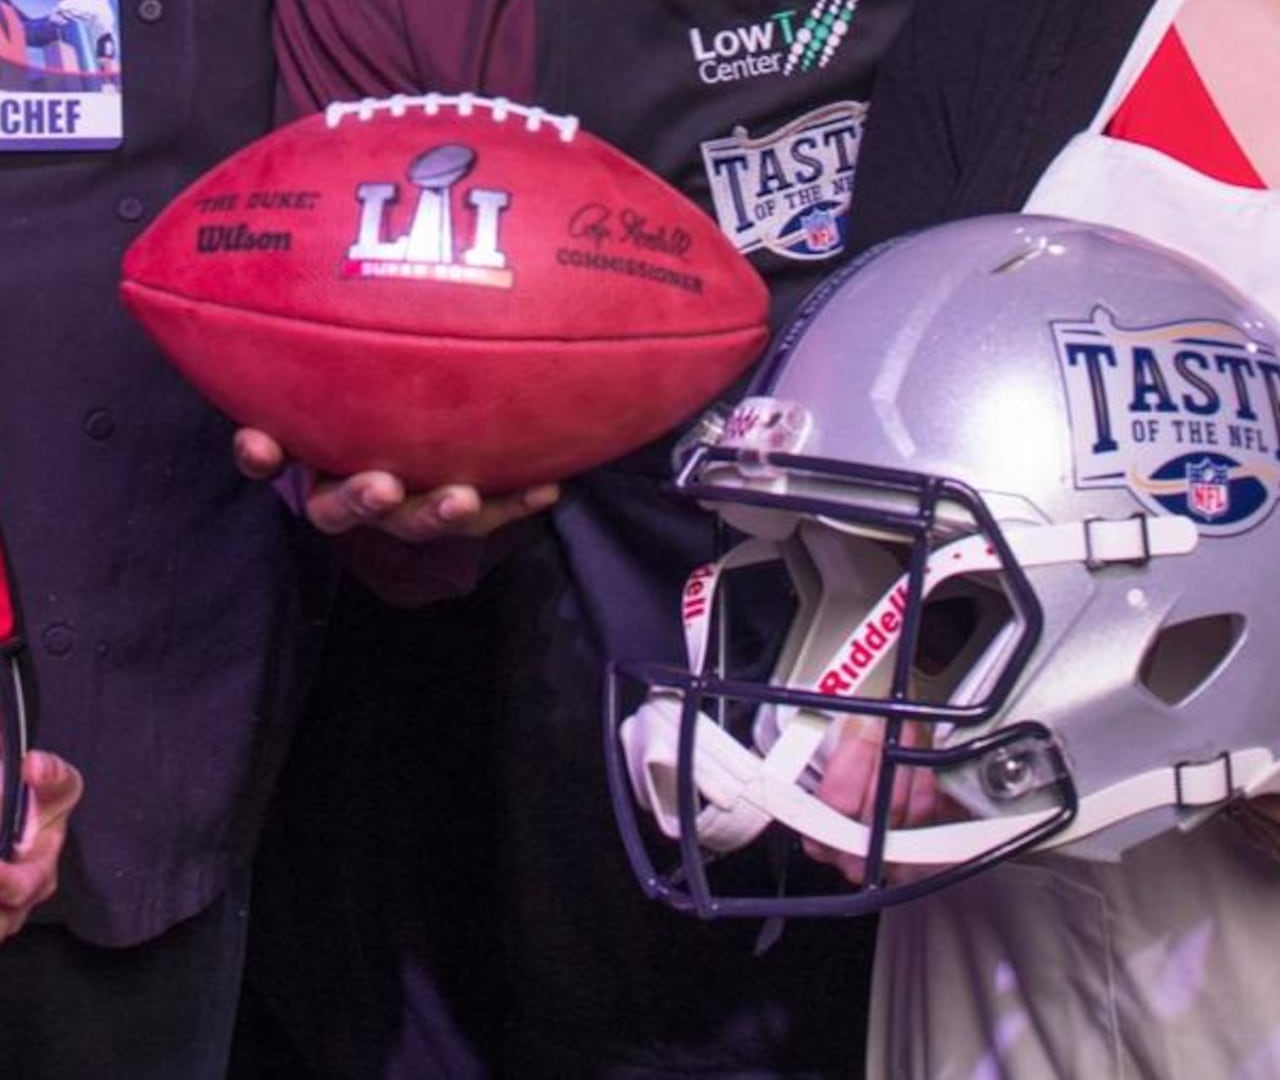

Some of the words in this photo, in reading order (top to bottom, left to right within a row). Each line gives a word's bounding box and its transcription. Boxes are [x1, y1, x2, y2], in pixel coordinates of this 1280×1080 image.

[699, 52, 782, 84] Center
[0, 98, 81, 135] CHEF
[713, 126, 856, 234] TAST
[754, 200, 775, 221] OF
[784, 185, 822, 210] THE
[832, 176, 855, 196] NF
[197, 222, 291, 253] Wilson
[1132, 420, 1159, 443] OF
[1170, 420, 1218, 445] THE
[1227, 424, 1269, 453] NFL
[1193, 487, 1226, 512] NFL
